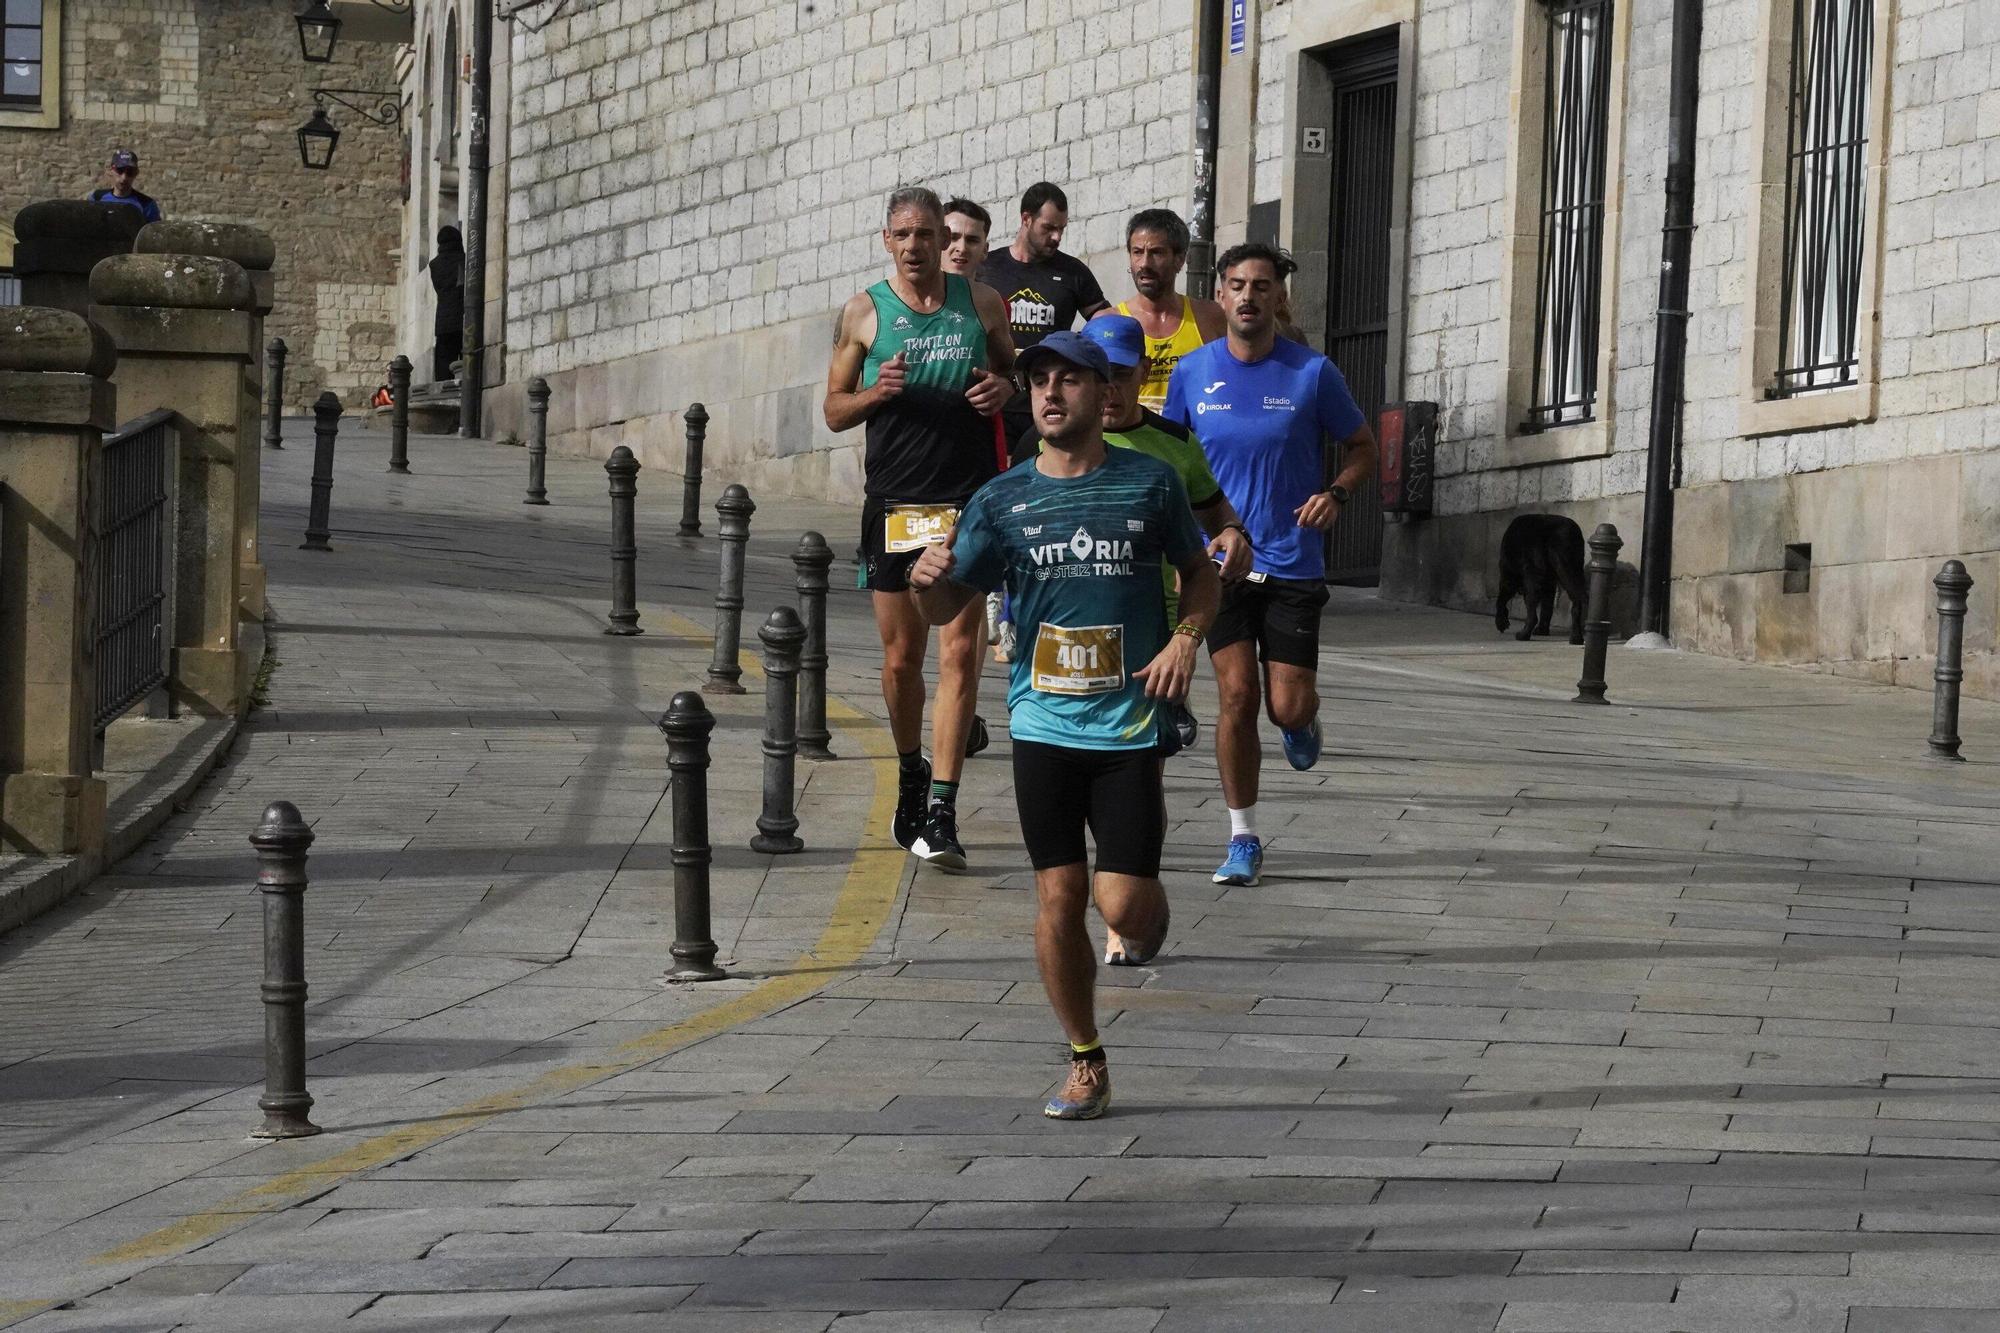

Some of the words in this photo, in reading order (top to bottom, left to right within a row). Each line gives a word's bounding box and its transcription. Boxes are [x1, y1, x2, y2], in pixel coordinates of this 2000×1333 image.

[1307, 131, 1321, 149] 5
[903, 333, 962, 351] TRIATLON
[893, 346, 975, 364] LLAMURIEL
[1263, 396, 1290, 405] Estadio
[907, 516, 941, 536] 554
[1022, 524, 1042, 537] Vital
[1035, 563, 1090, 581] GASTEIZ
[1092, 563, 1134, 576] TRAIL
[1056, 644, 1098, 670] 401
